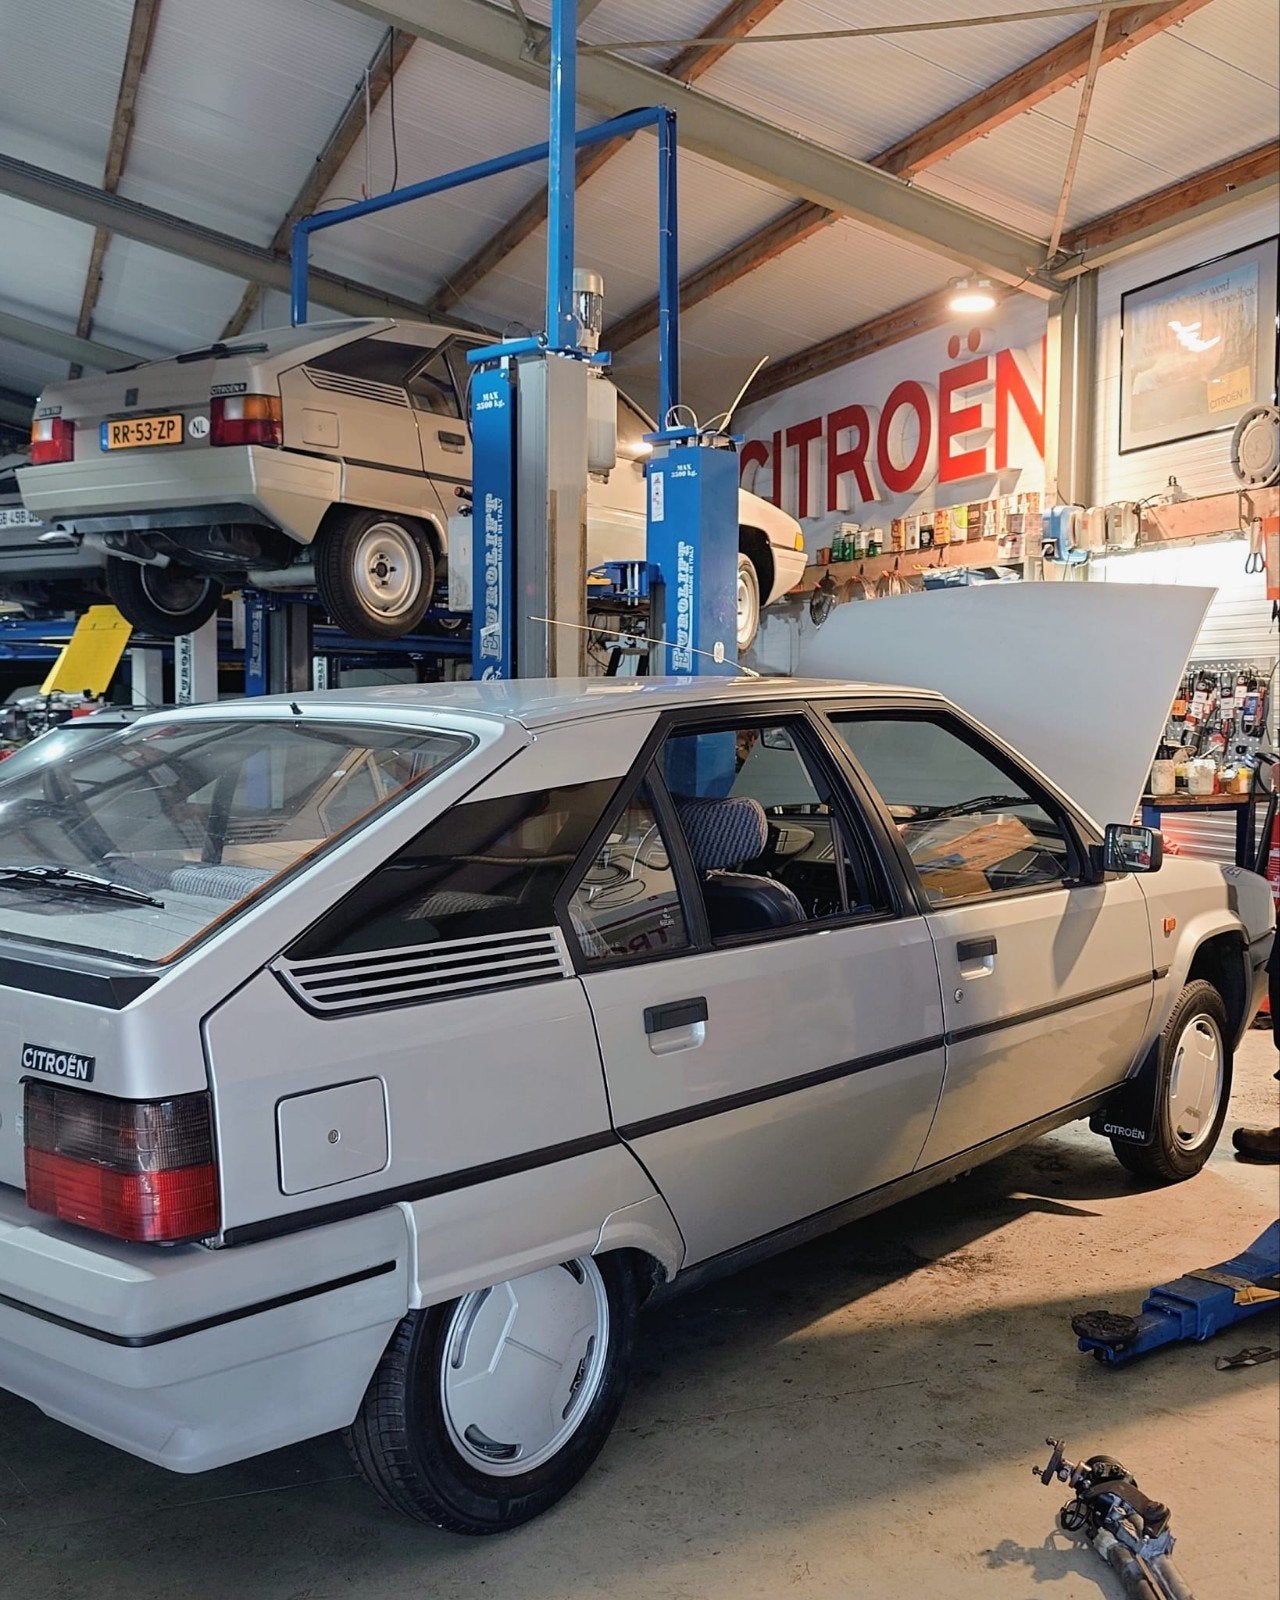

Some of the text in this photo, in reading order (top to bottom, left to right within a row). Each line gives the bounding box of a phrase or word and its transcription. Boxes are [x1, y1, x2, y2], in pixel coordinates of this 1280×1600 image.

[483, 391, 499, 401] MAX
[113, 420, 176, 443] RR-53-ZP
[192, 421, 206, 434] NL
[676, 463, 692, 471] MAX
[672, 541, 692, 673] EUROLIFT
[23, 1048, 89, 1080] CITROËN
[1104, 1123, 1145, 1140] CITROËN
